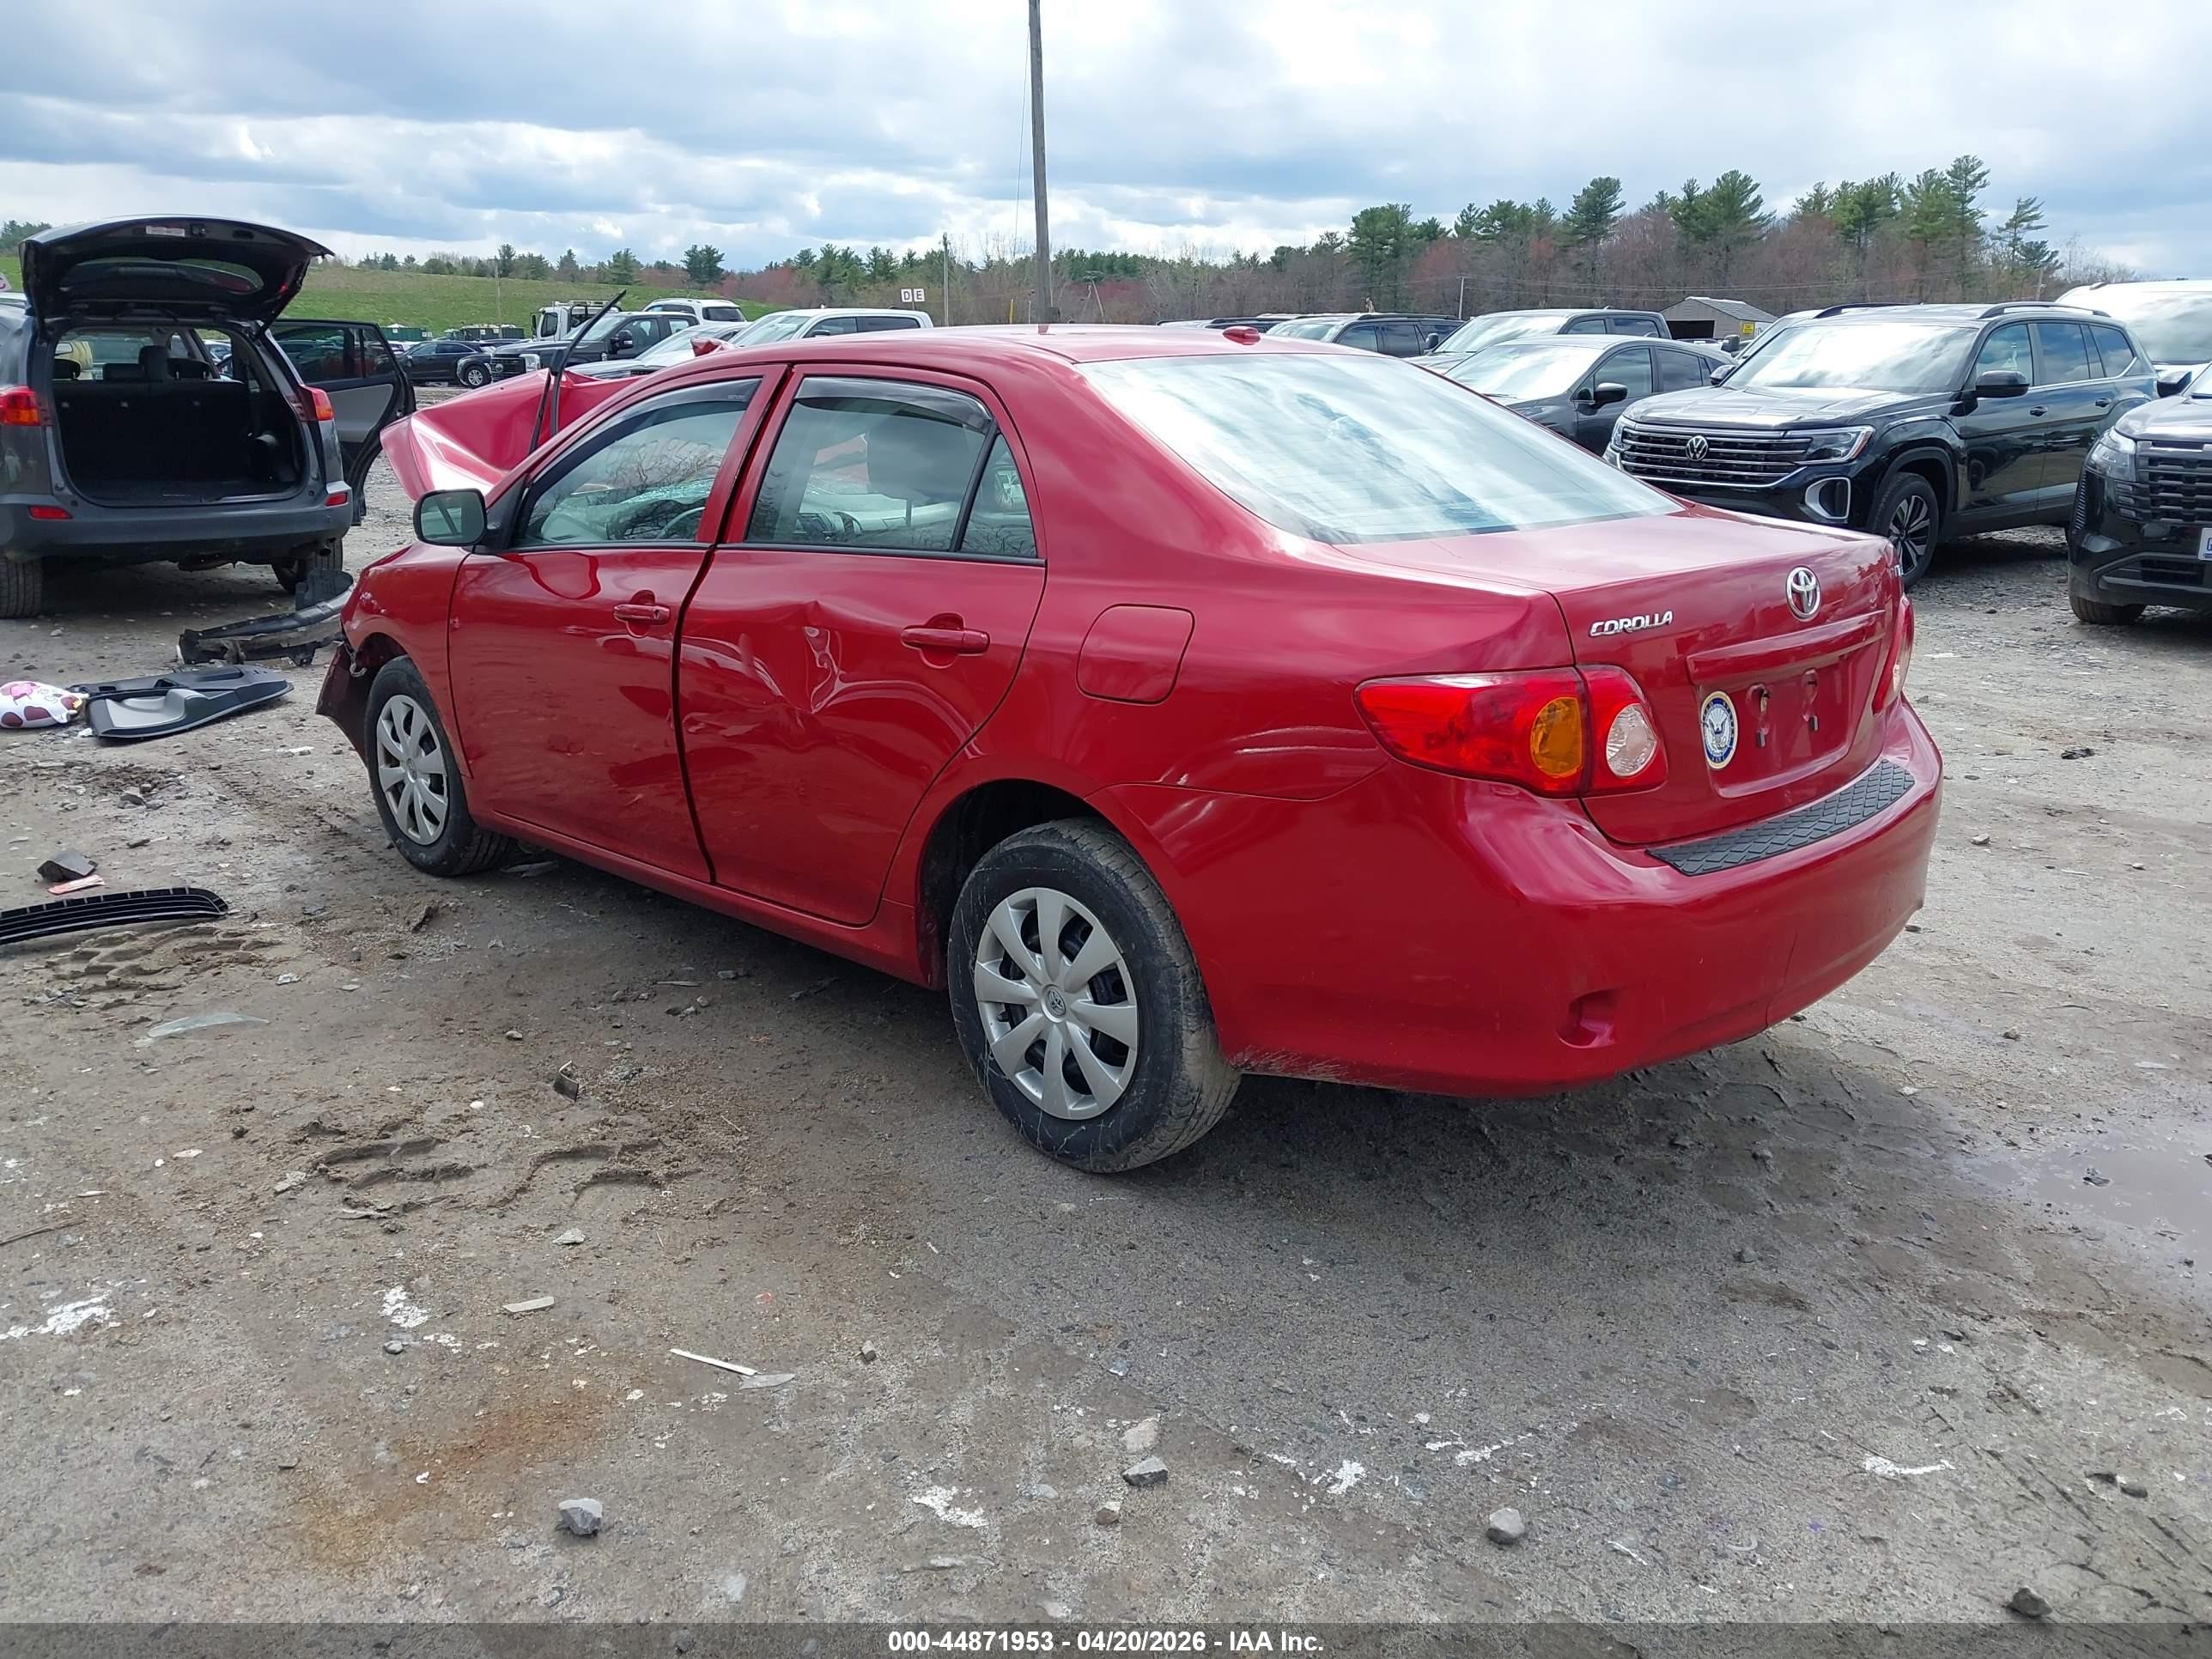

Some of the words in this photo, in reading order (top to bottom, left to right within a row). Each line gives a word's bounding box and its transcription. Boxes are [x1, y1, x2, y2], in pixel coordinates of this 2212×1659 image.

[903, 290, 910, 301] D
[916, 290, 922, 301] E
[1589, 611, 1674, 637] COROLLA
